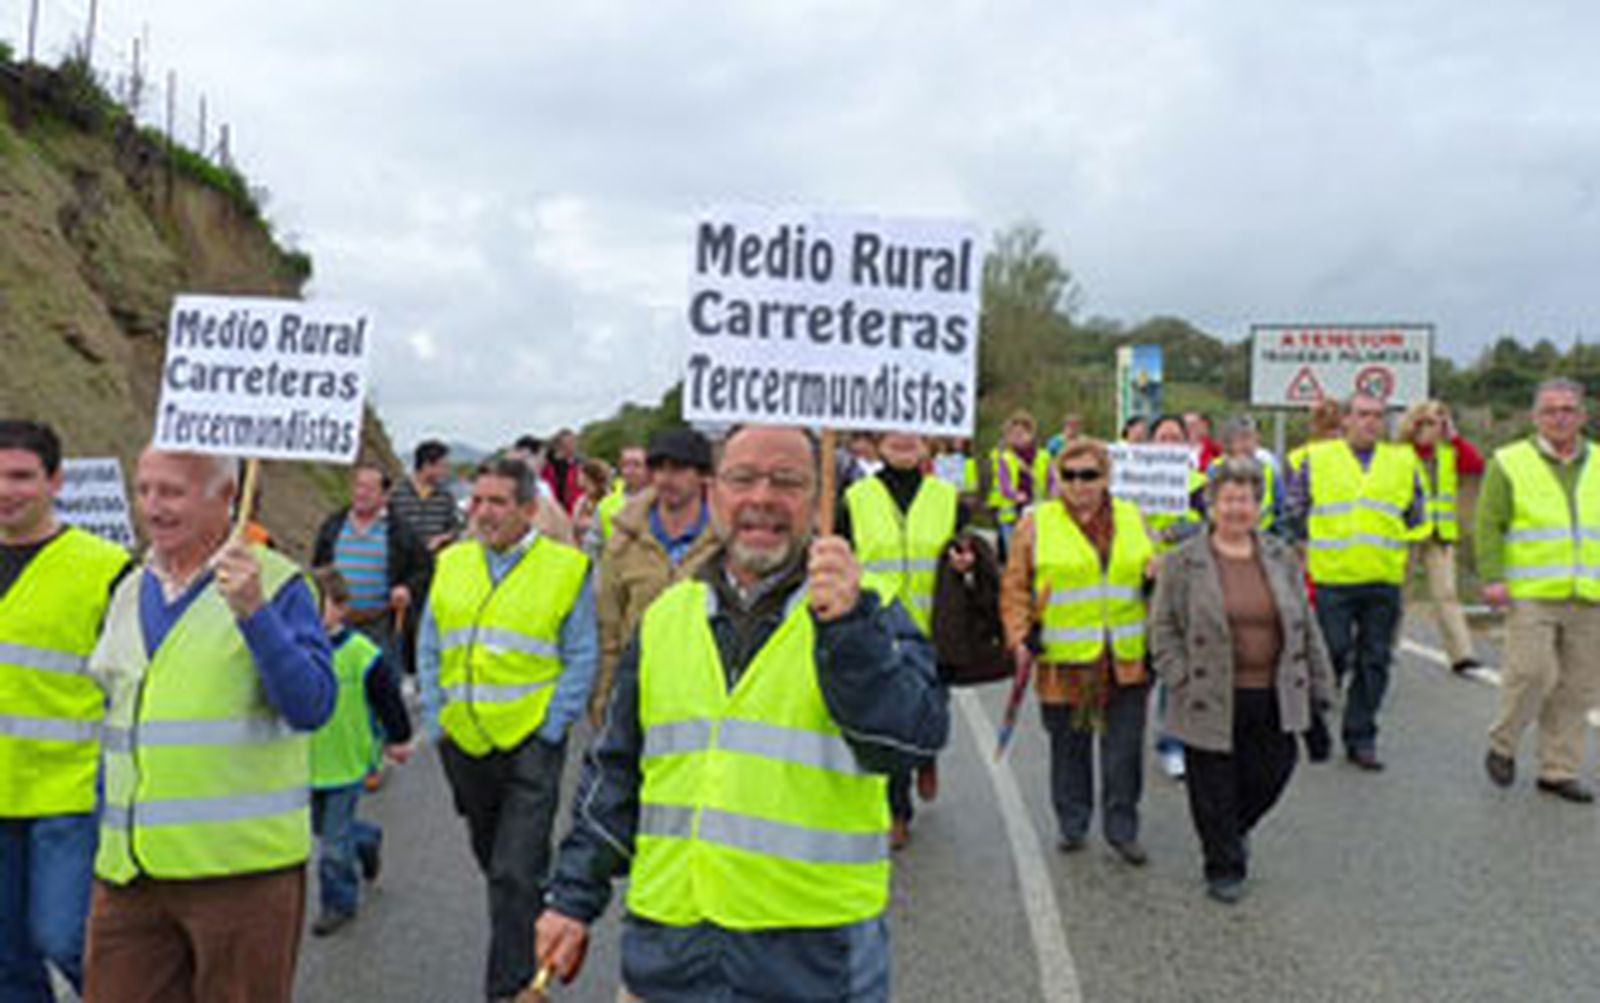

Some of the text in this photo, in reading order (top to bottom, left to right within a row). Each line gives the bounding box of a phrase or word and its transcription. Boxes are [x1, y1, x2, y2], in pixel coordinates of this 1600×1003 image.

[696, 222, 972, 292] Medio Rural
[175, 310, 367, 355] Medio Rural
[689, 290, 968, 354] Carreteras
[167, 355, 358, 400] Carreteras
[688, 353, 966, 426] Tercermundistas
[161, 403, 355, 454] Tercermundistas
